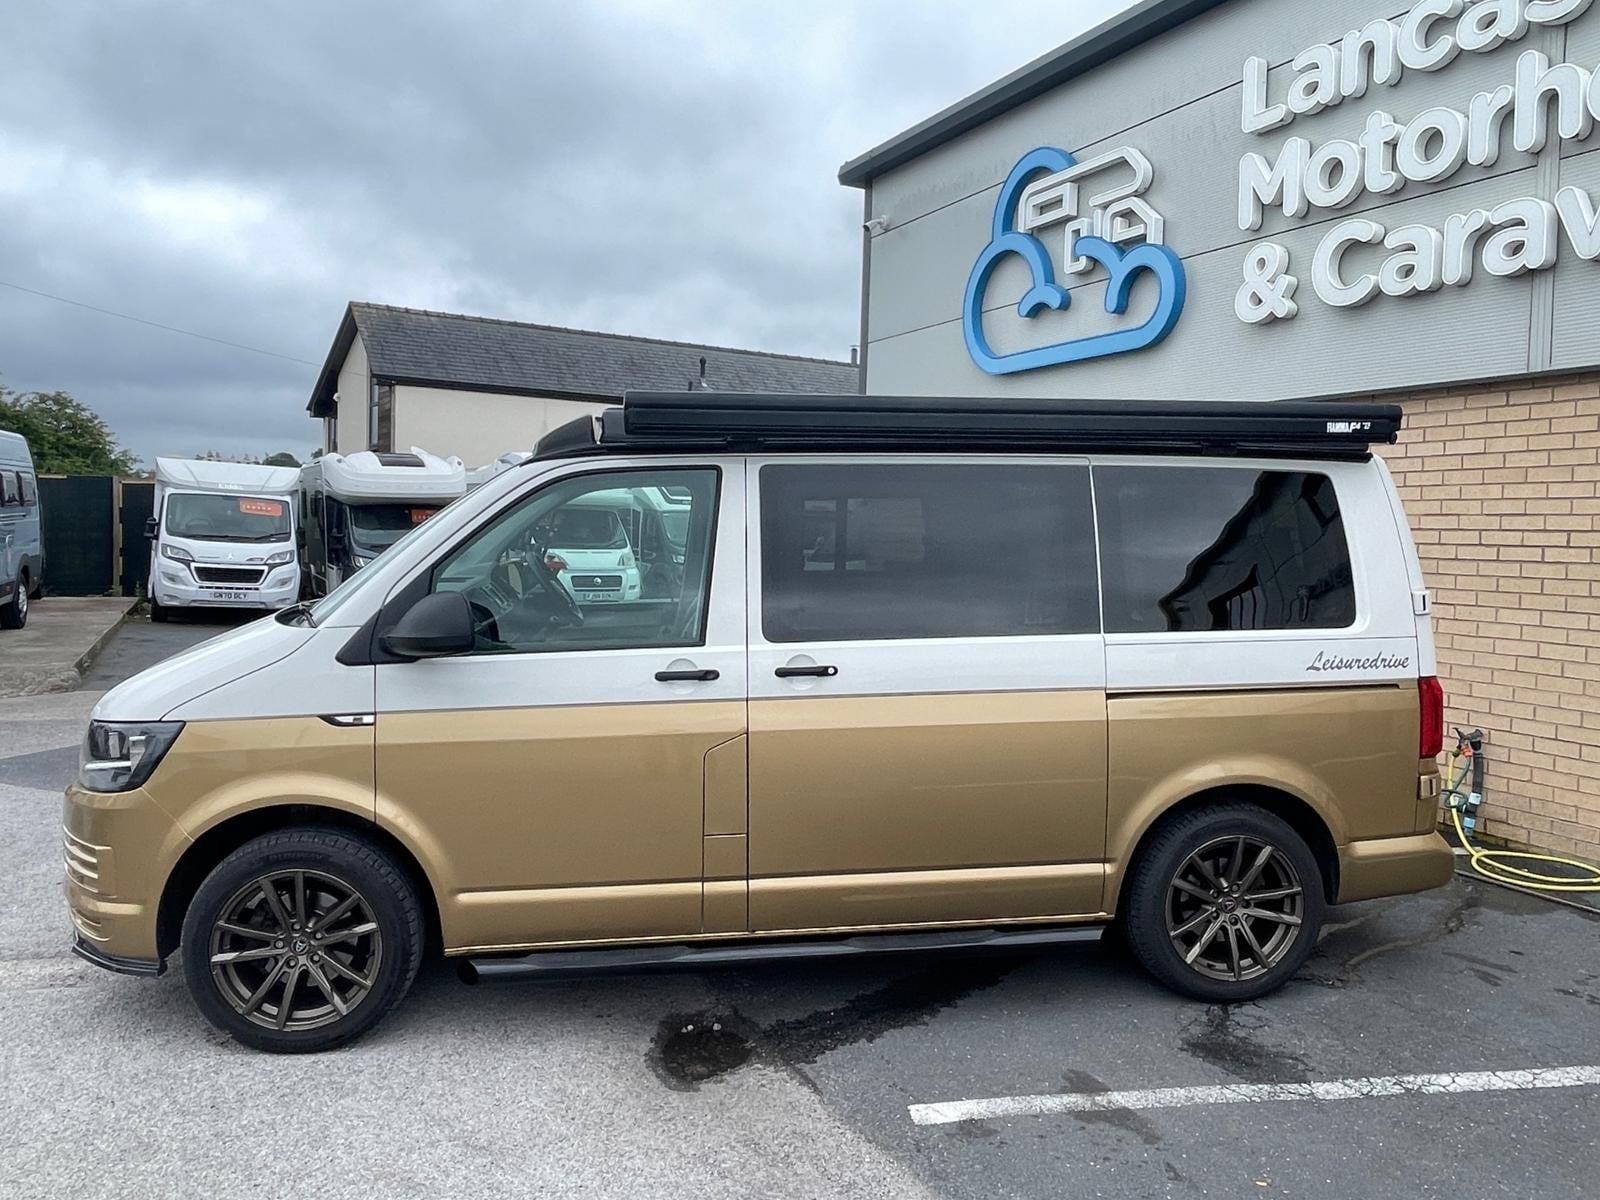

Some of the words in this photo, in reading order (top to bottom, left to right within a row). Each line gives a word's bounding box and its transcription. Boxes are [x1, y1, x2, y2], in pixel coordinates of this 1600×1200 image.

[1238, 50, 1600, 231] Motorh
[1235, 242, 1298, 323] &
[1306, 650, 1409, 672] Leisuredrive
